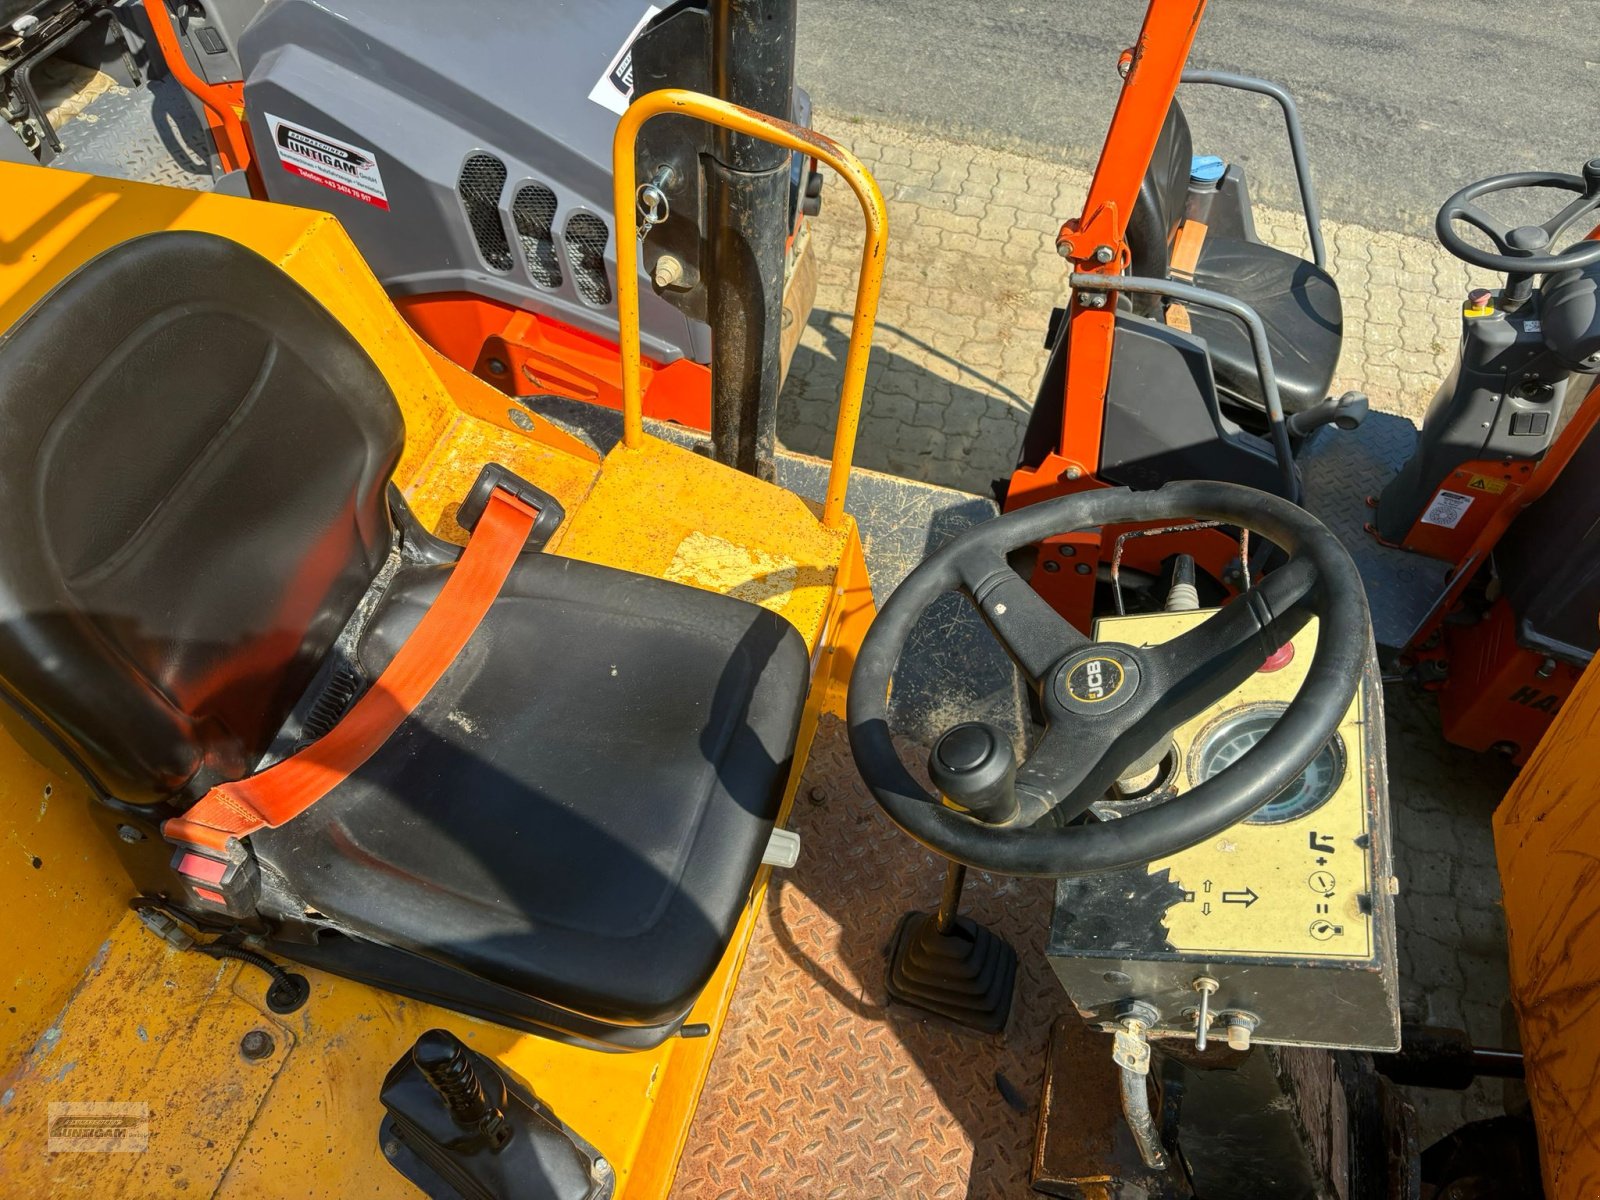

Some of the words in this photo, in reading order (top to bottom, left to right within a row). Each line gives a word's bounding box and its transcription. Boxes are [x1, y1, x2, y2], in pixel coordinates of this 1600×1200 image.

[290, 131, 345, 157] BAUMASCHINEN
[1087, 660, 1104, 698] JCB
[1507, 684, 1560, 716] HA
